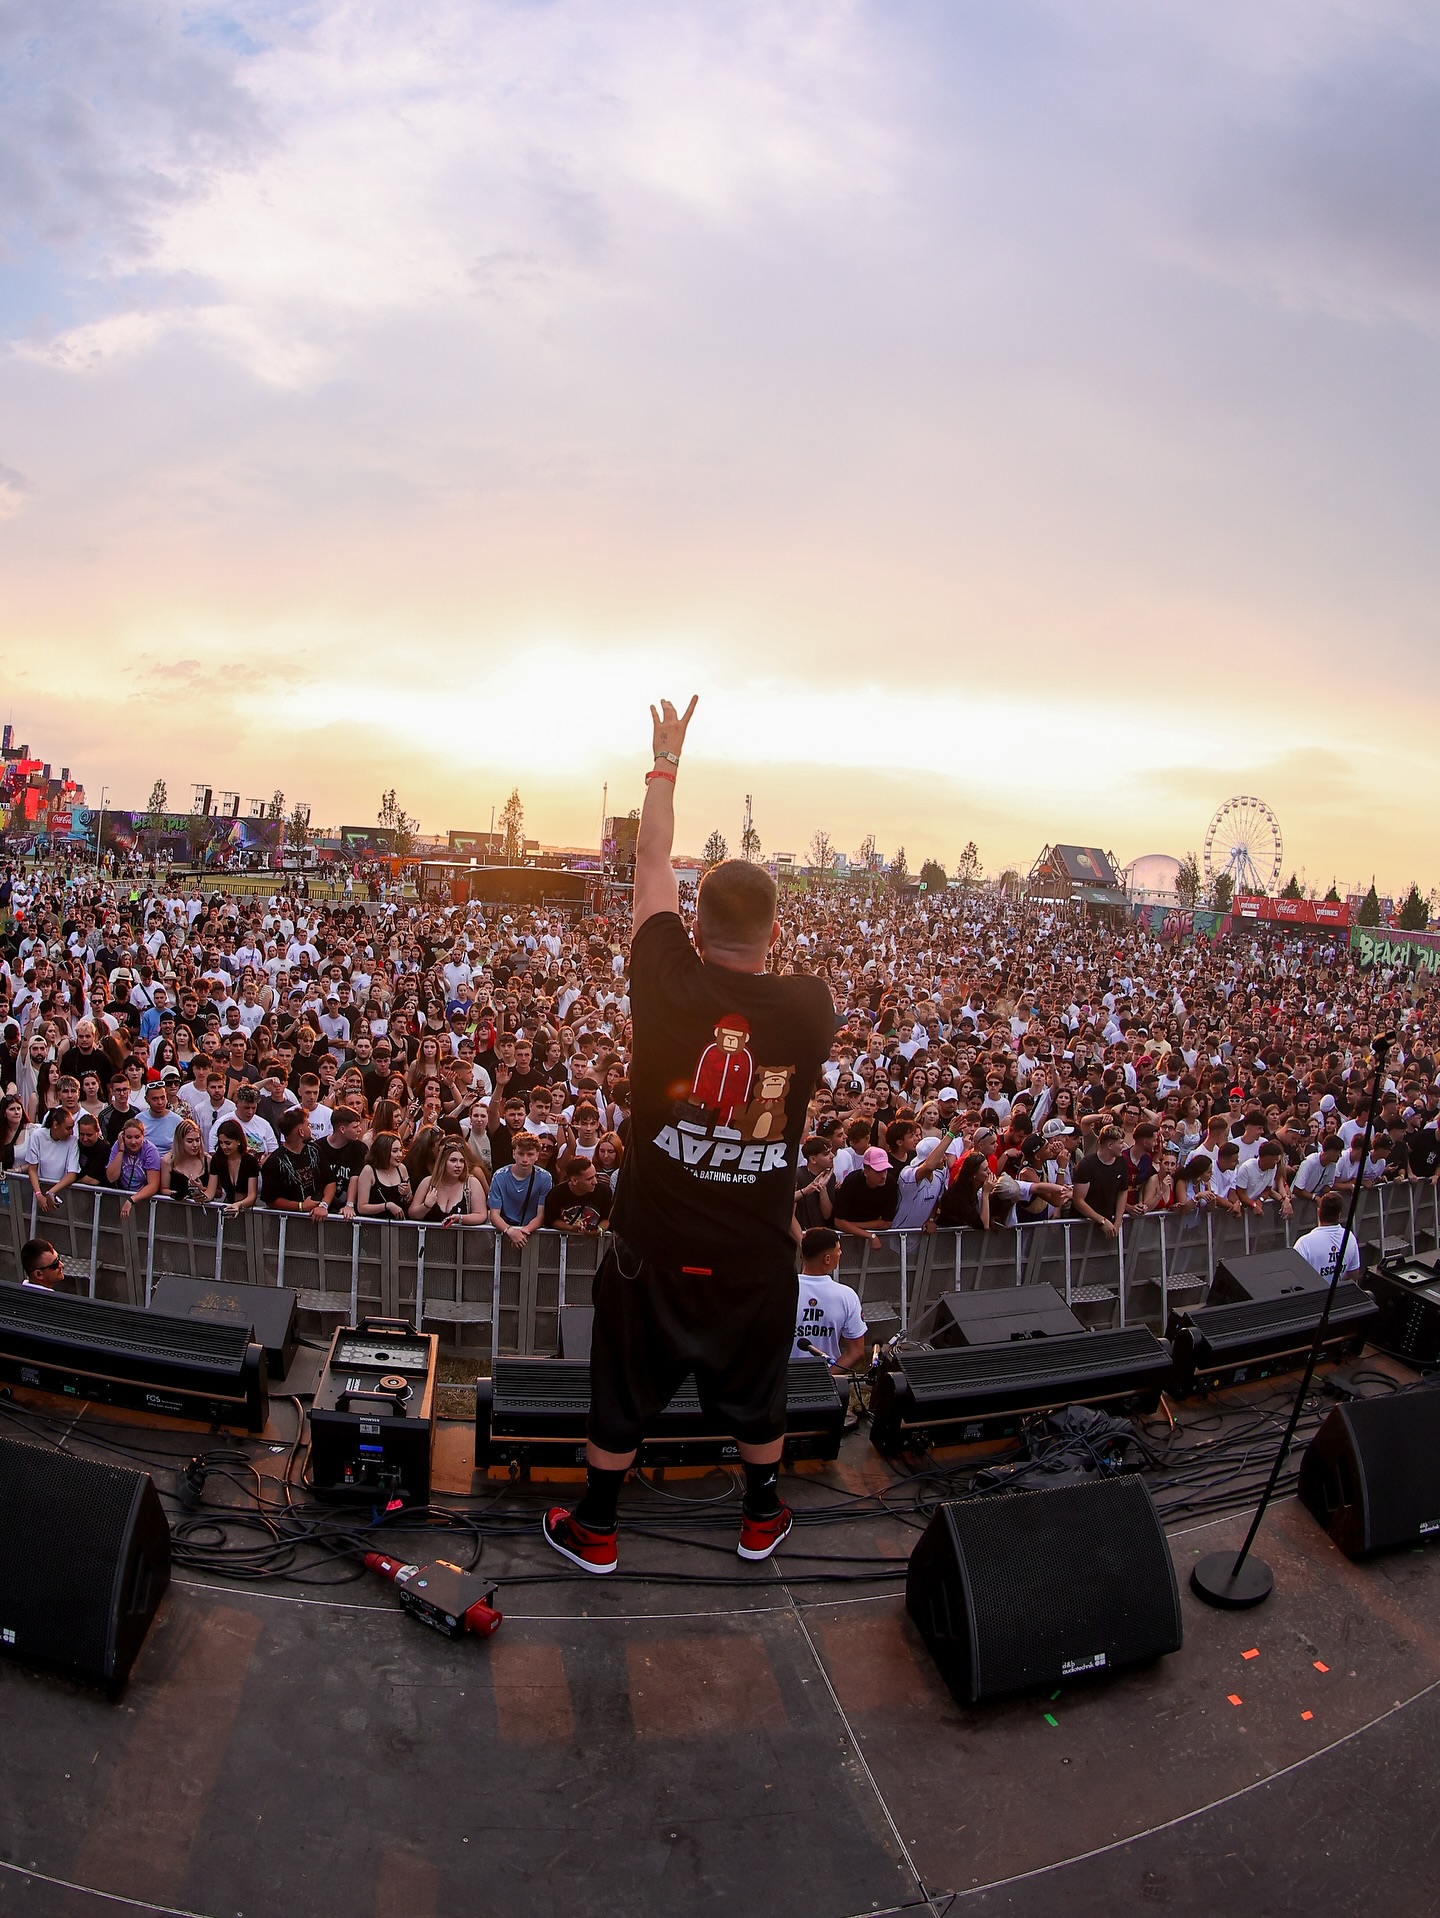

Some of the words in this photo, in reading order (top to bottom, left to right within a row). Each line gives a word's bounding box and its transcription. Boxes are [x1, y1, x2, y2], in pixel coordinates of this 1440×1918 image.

[1240, 902, 1260, 910] DRINKS
[1316, 909, 1339, 917] DRINKS
[1360, 934, 1410, 966] BEACH
[699, 1170, 732, 1183] BATHING
[1320, 1264, 1347, 1277] ESCT
[802, 1308, 825, 1322] ZIP
[1062, 1661, 1076, 1669] d&b
